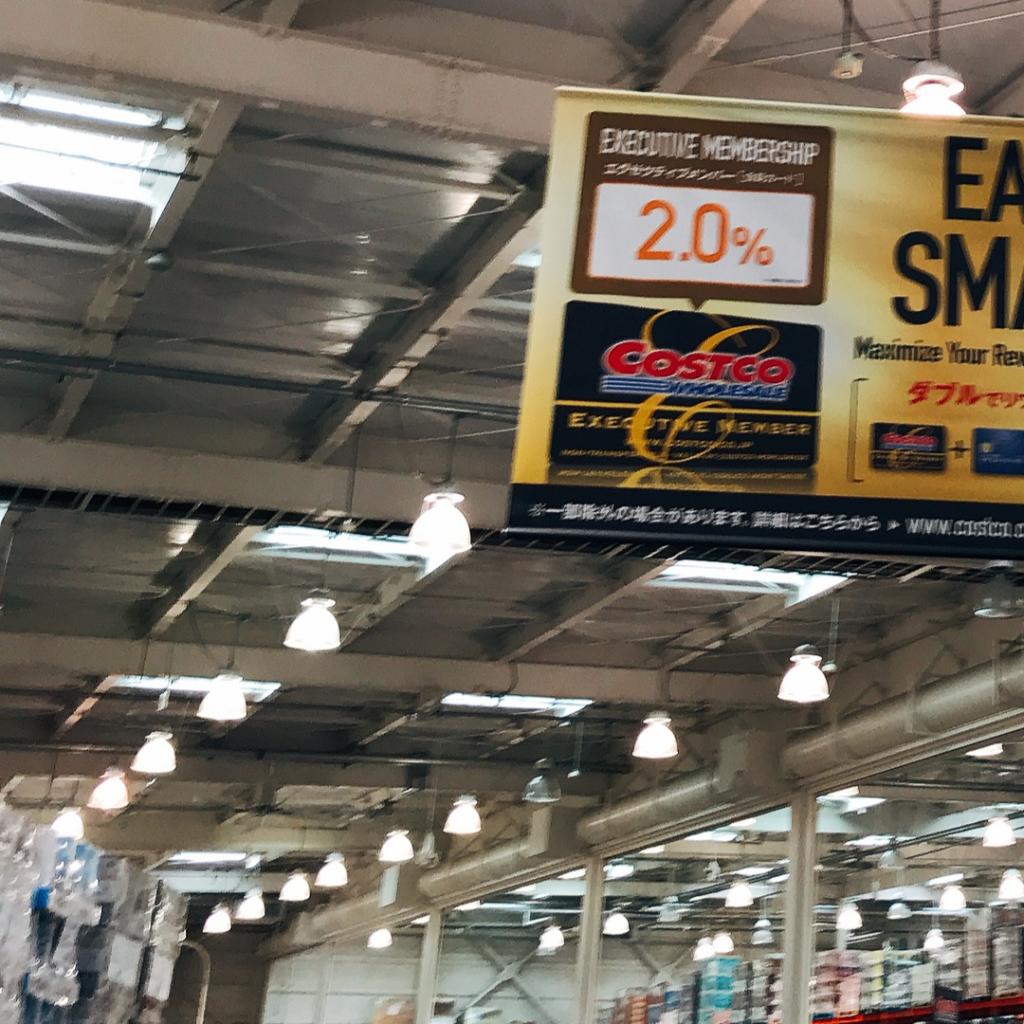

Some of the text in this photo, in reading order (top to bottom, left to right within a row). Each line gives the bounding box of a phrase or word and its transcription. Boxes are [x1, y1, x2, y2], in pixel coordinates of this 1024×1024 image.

[600, 128, 820, 166] EXECUTIVE MEMBERSHIP
[635, 199, 774, 266] 2.0%
[602, 339, 796, 385] COSTCO
[853, 336, 943, 362] Maximize
[946, 341, 989, 365] Your
[668, 381, 787, 398] WHOLESALE
